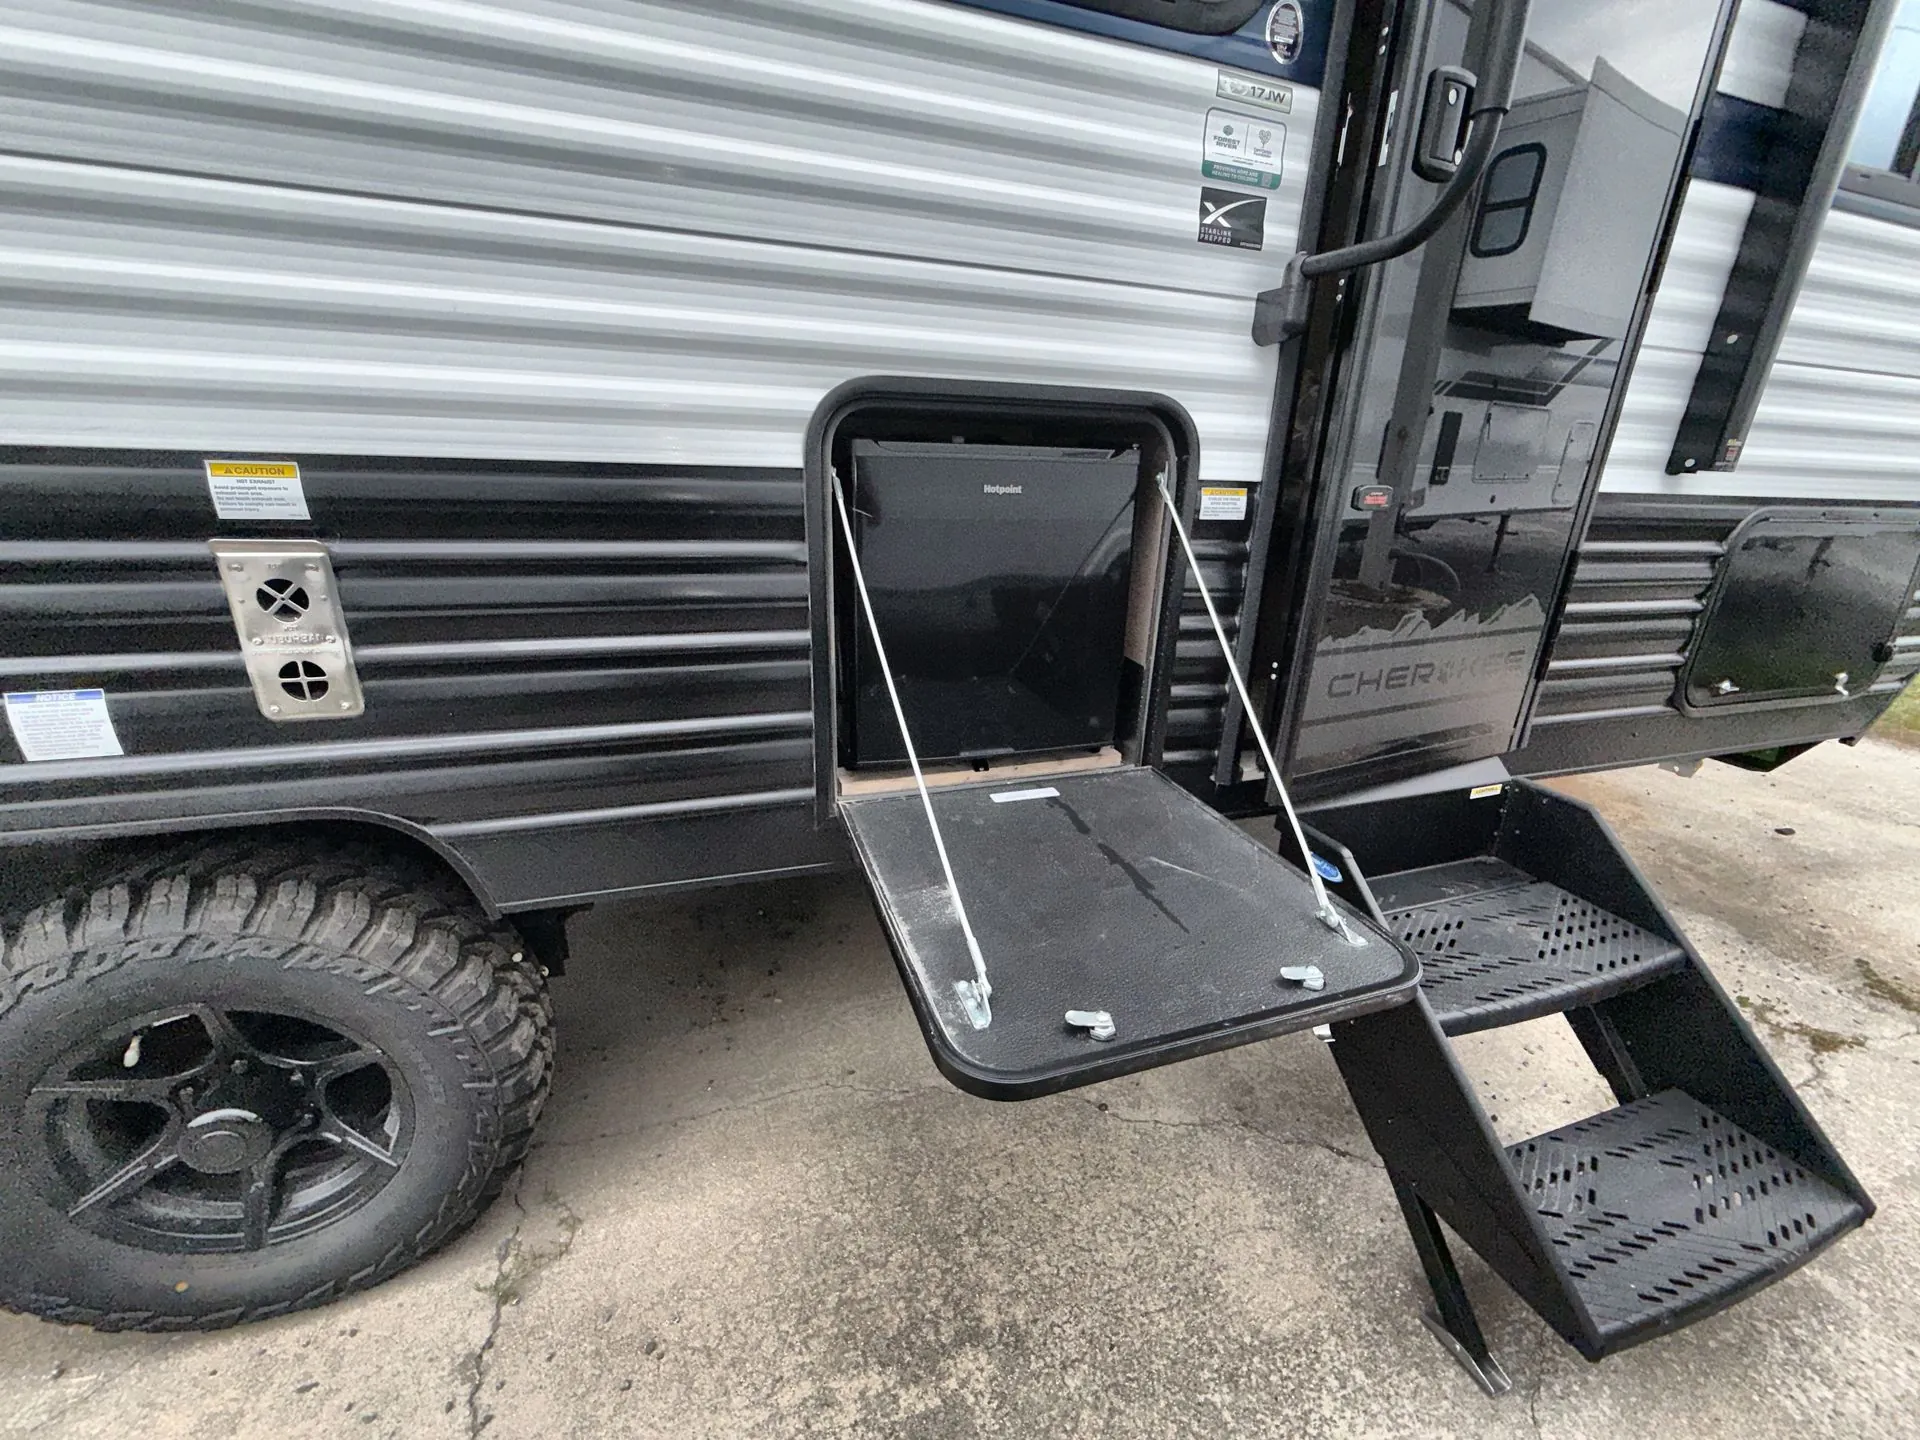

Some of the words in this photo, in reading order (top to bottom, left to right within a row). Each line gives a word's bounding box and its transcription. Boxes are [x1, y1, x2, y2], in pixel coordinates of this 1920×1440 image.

[1250, 86, 1287, 104] 17JW
[1213, 135, 1241, 146] FOREST
[1215, 141, 1238, 150] RIVER
[1200, 227, 1232, 236] STARLINK
[1199, 233, 1232, 244] PREPPED
[234, 466, 285, 476] CAUTION
[983, 484, 1022, 495] Hotpoint
